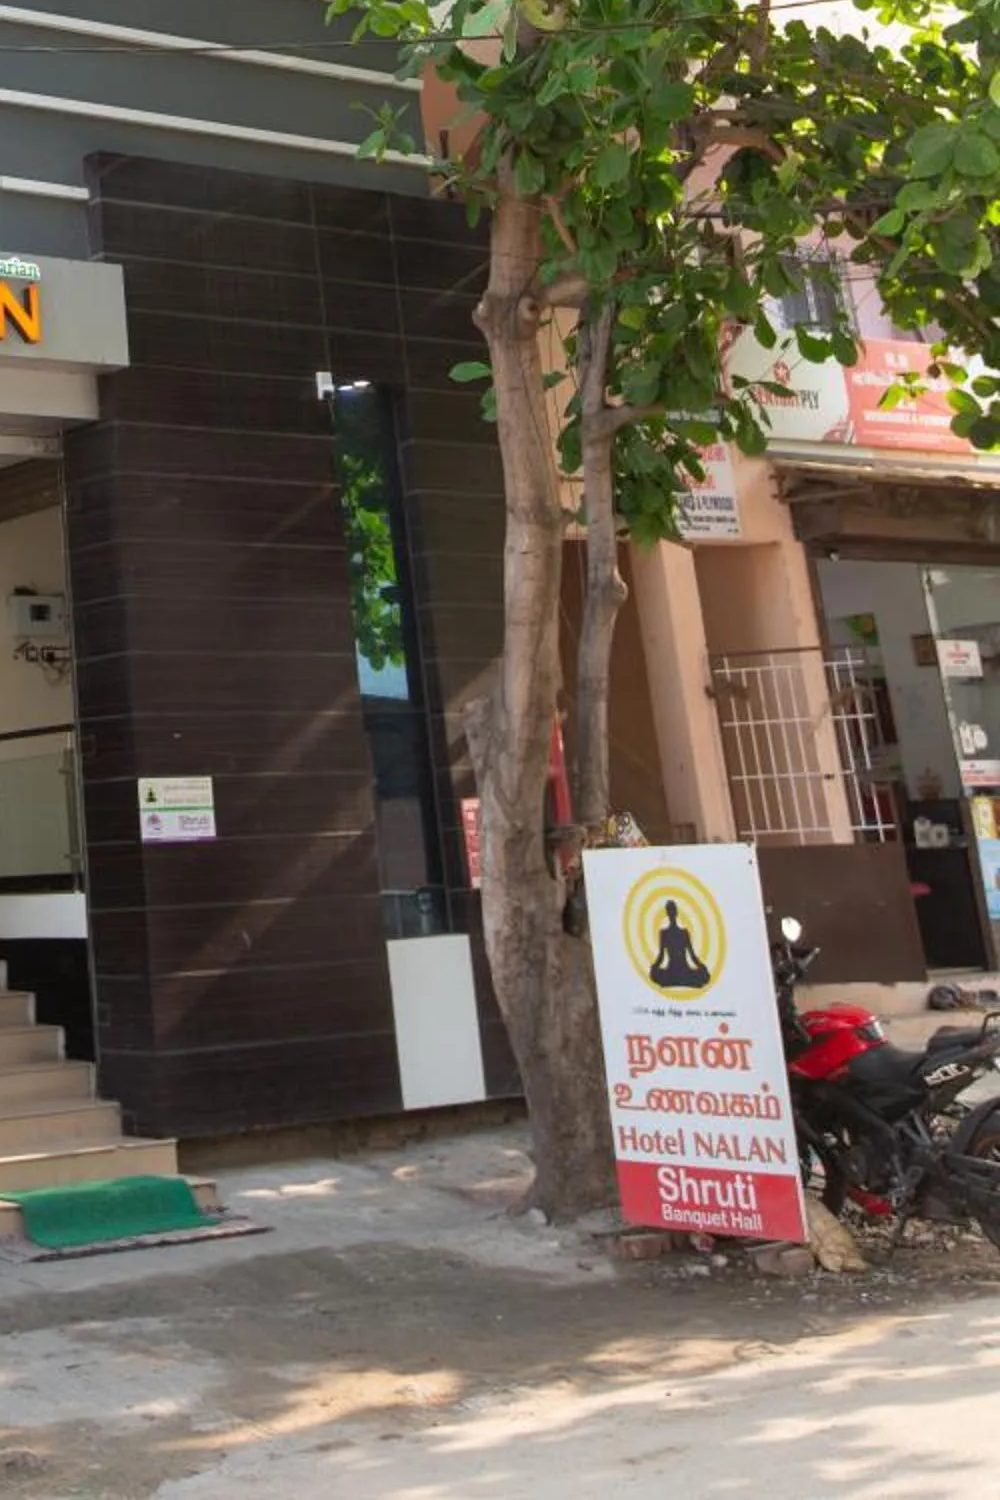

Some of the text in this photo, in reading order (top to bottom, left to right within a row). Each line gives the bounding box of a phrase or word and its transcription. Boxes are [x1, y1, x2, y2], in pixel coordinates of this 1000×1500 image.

[625, 1022, 752, 1078] நளன்
[614, 1082, 782, 1121] உணவகம்
[618, 1125, 788, 1165] Hotel NALAN
[657, 1165, 758, 1210] Shruti
[661, 1203, 763, 1232] Banquet Hall
